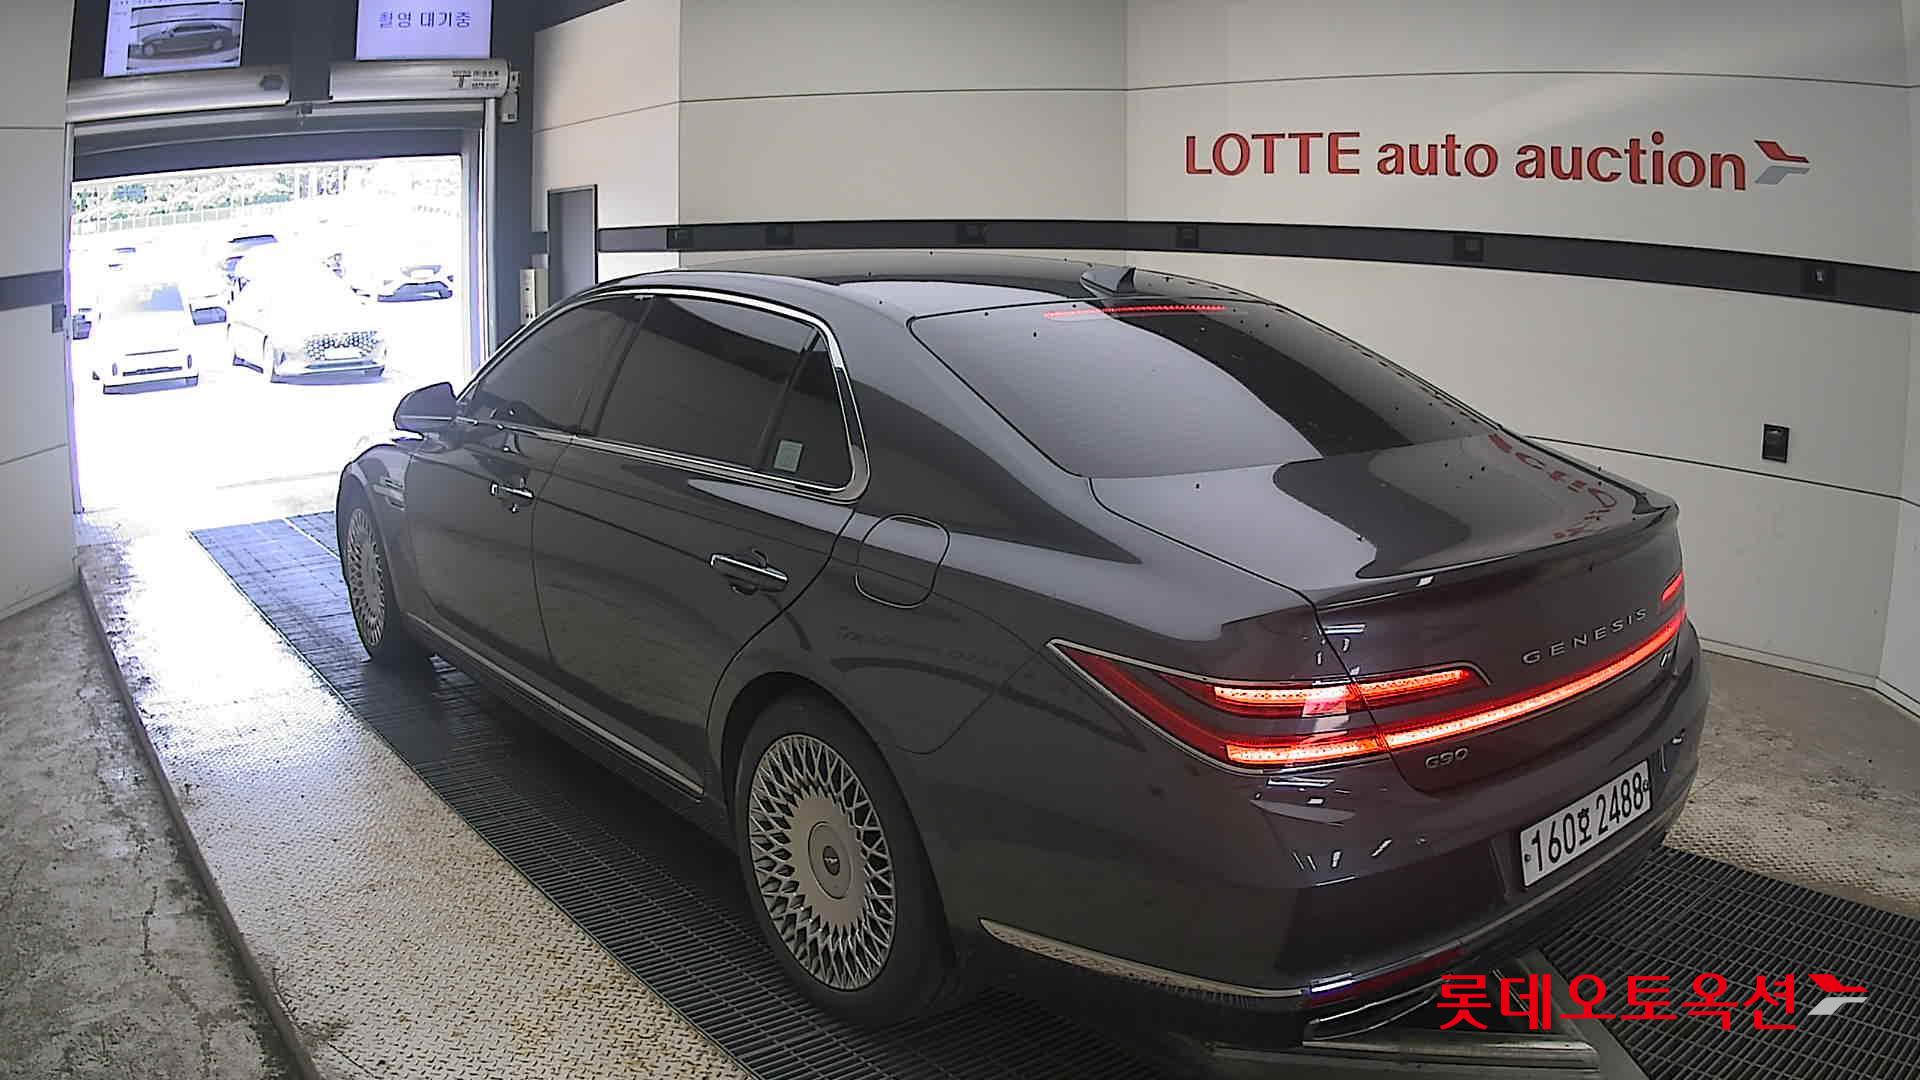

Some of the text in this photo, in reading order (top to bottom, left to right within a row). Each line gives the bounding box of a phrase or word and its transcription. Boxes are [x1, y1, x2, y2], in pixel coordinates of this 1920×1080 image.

[420, 11, 472, 28] 대기중
[1185, 132, 1745, 189] LOTTE auto auction
[1523, 608, 1648, 664] GENESIS
[1425, 747, 1469, 769] G90
[1531, 772, 1644, 872] 160호 2488
